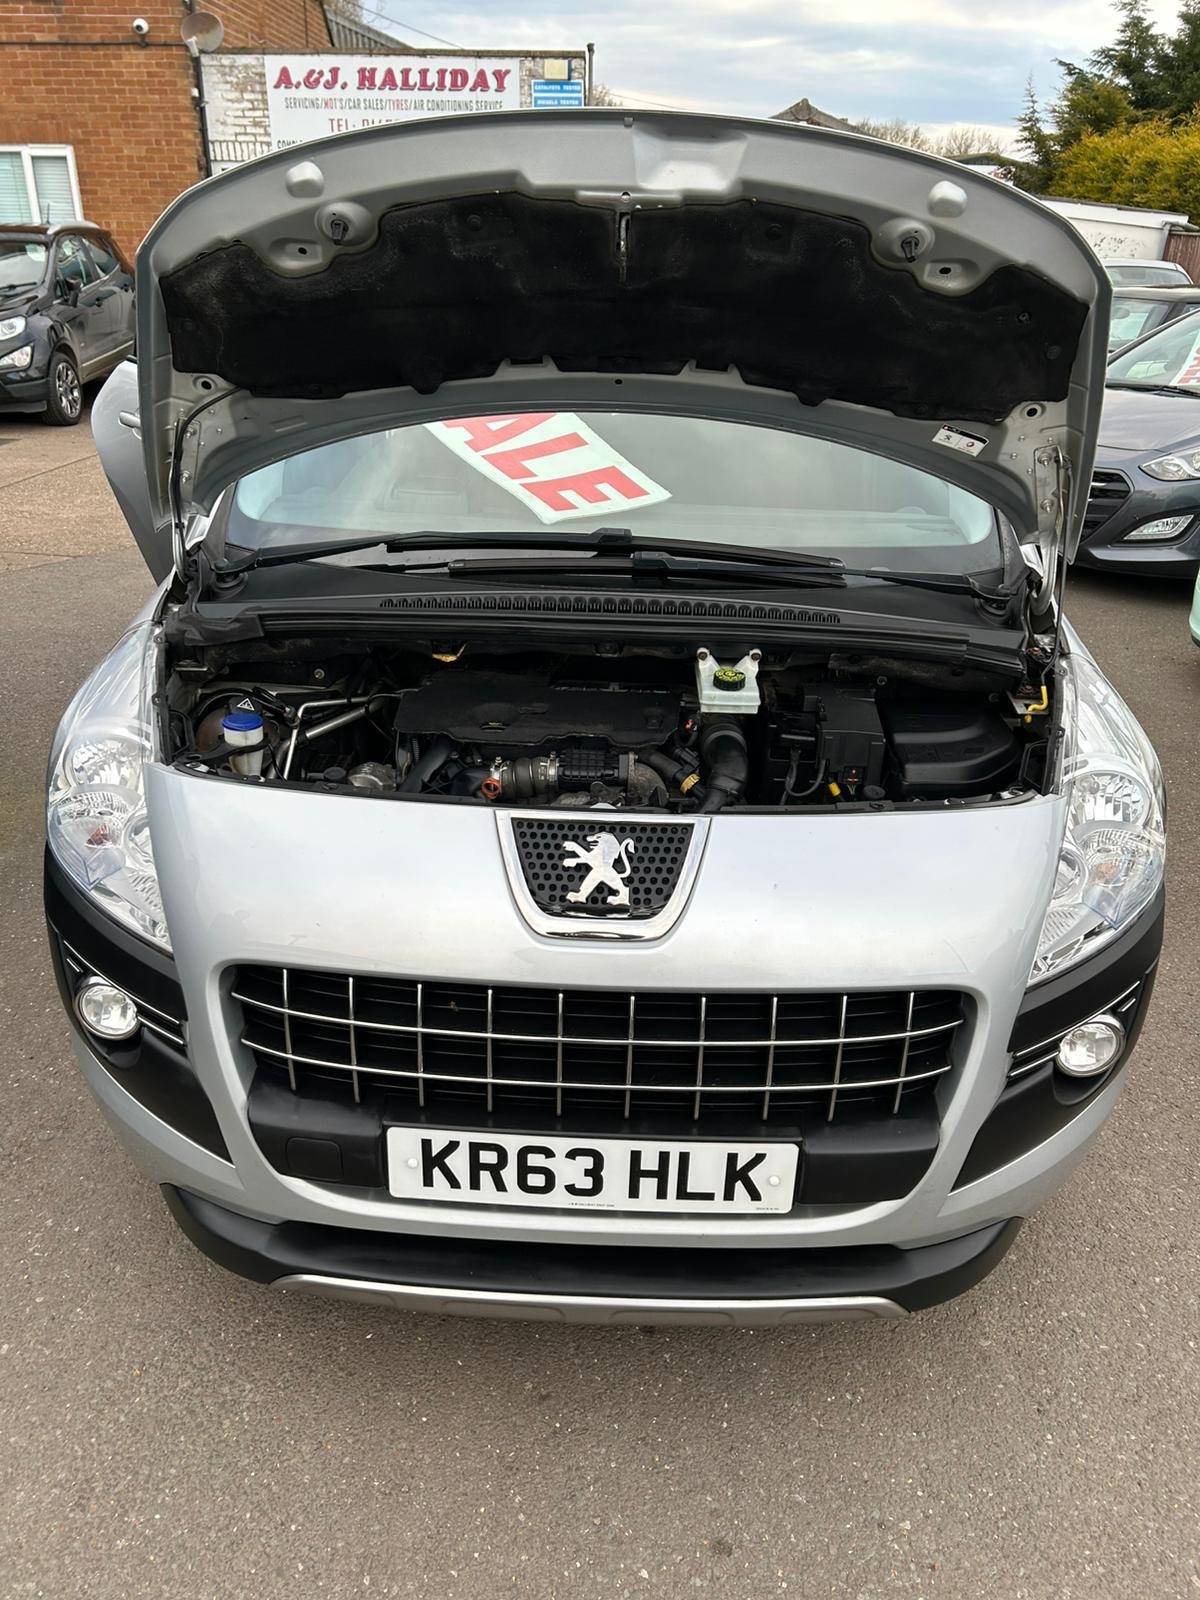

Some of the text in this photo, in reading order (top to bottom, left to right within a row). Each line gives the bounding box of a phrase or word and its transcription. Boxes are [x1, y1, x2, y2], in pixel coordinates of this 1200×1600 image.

[357, 67, 511, 92] HALLIDAY
[426, 99, 474, 111] CONDITIONING
[475, 100, 503, 111] SERVICE
[421, 1138, 768, 1202] KR63 HLK
